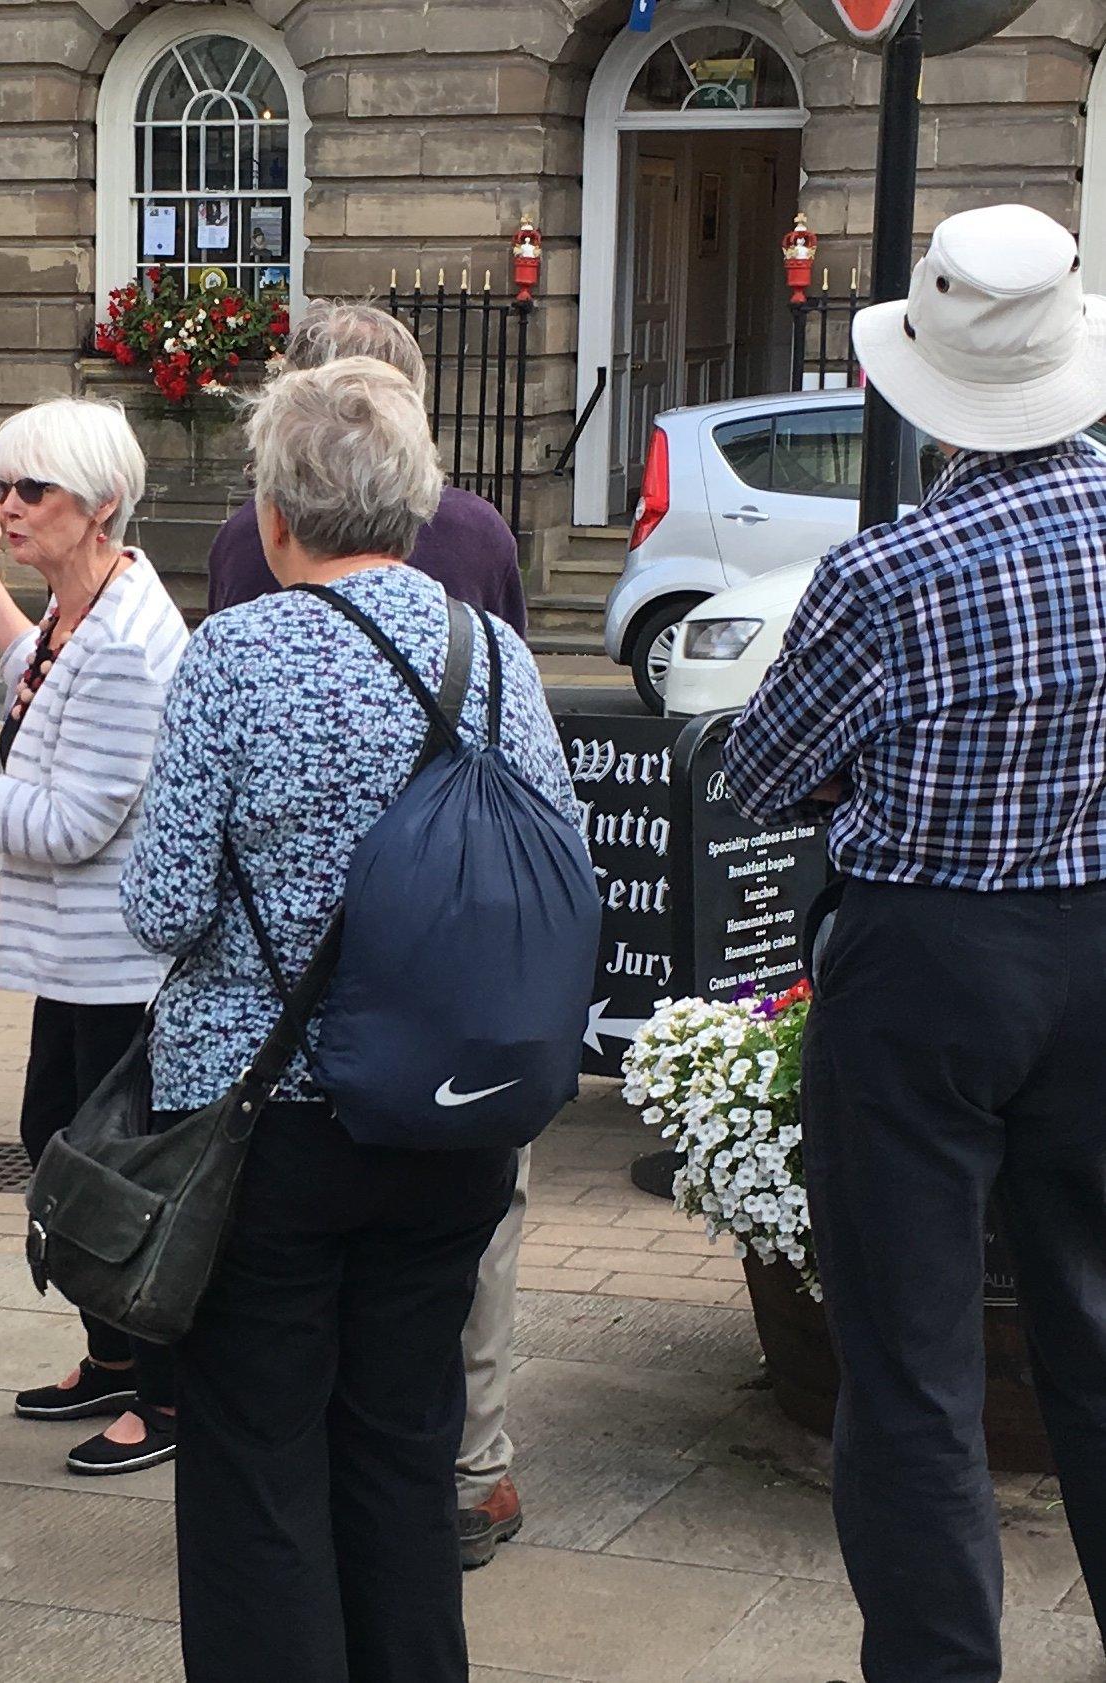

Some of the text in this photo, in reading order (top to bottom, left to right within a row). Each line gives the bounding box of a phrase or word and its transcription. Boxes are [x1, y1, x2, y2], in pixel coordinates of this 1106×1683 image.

[708, 825, 816, 859] Speciality coffees and teas
[728, 853, 796, 879] Breakfast bagels
[744, 885, 779, 903] Lunches
[726, 909, 795, 934] Homemade soup
[724, 934, 797, 961] Homemade cakes
[605, 941, 674, 987] Jury
[709, 973, 738, 992] Cream
